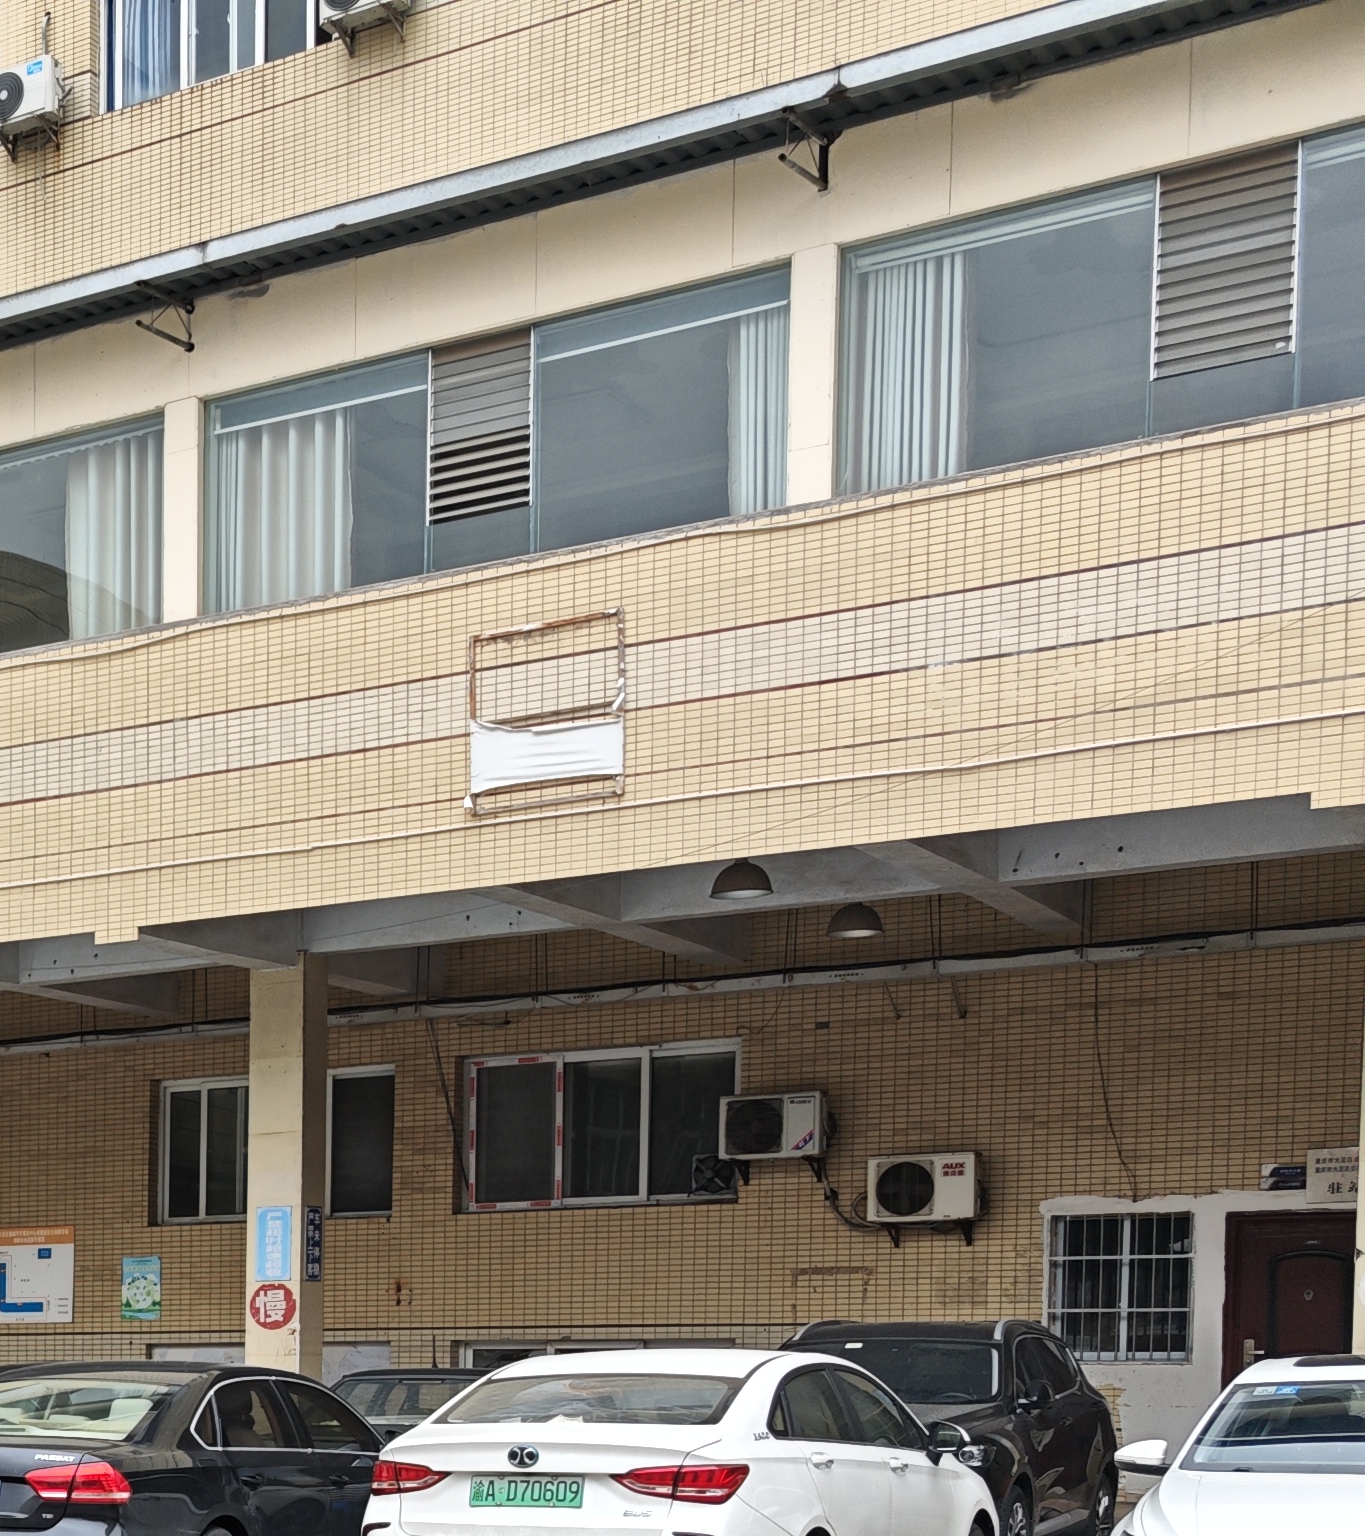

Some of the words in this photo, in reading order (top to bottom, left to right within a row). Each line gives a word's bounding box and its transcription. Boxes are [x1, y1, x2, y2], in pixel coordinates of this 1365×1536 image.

[1315, 1165, 1358, 1174] 重庆市大足区交
[255, 1290, 286, 1323] 慢
